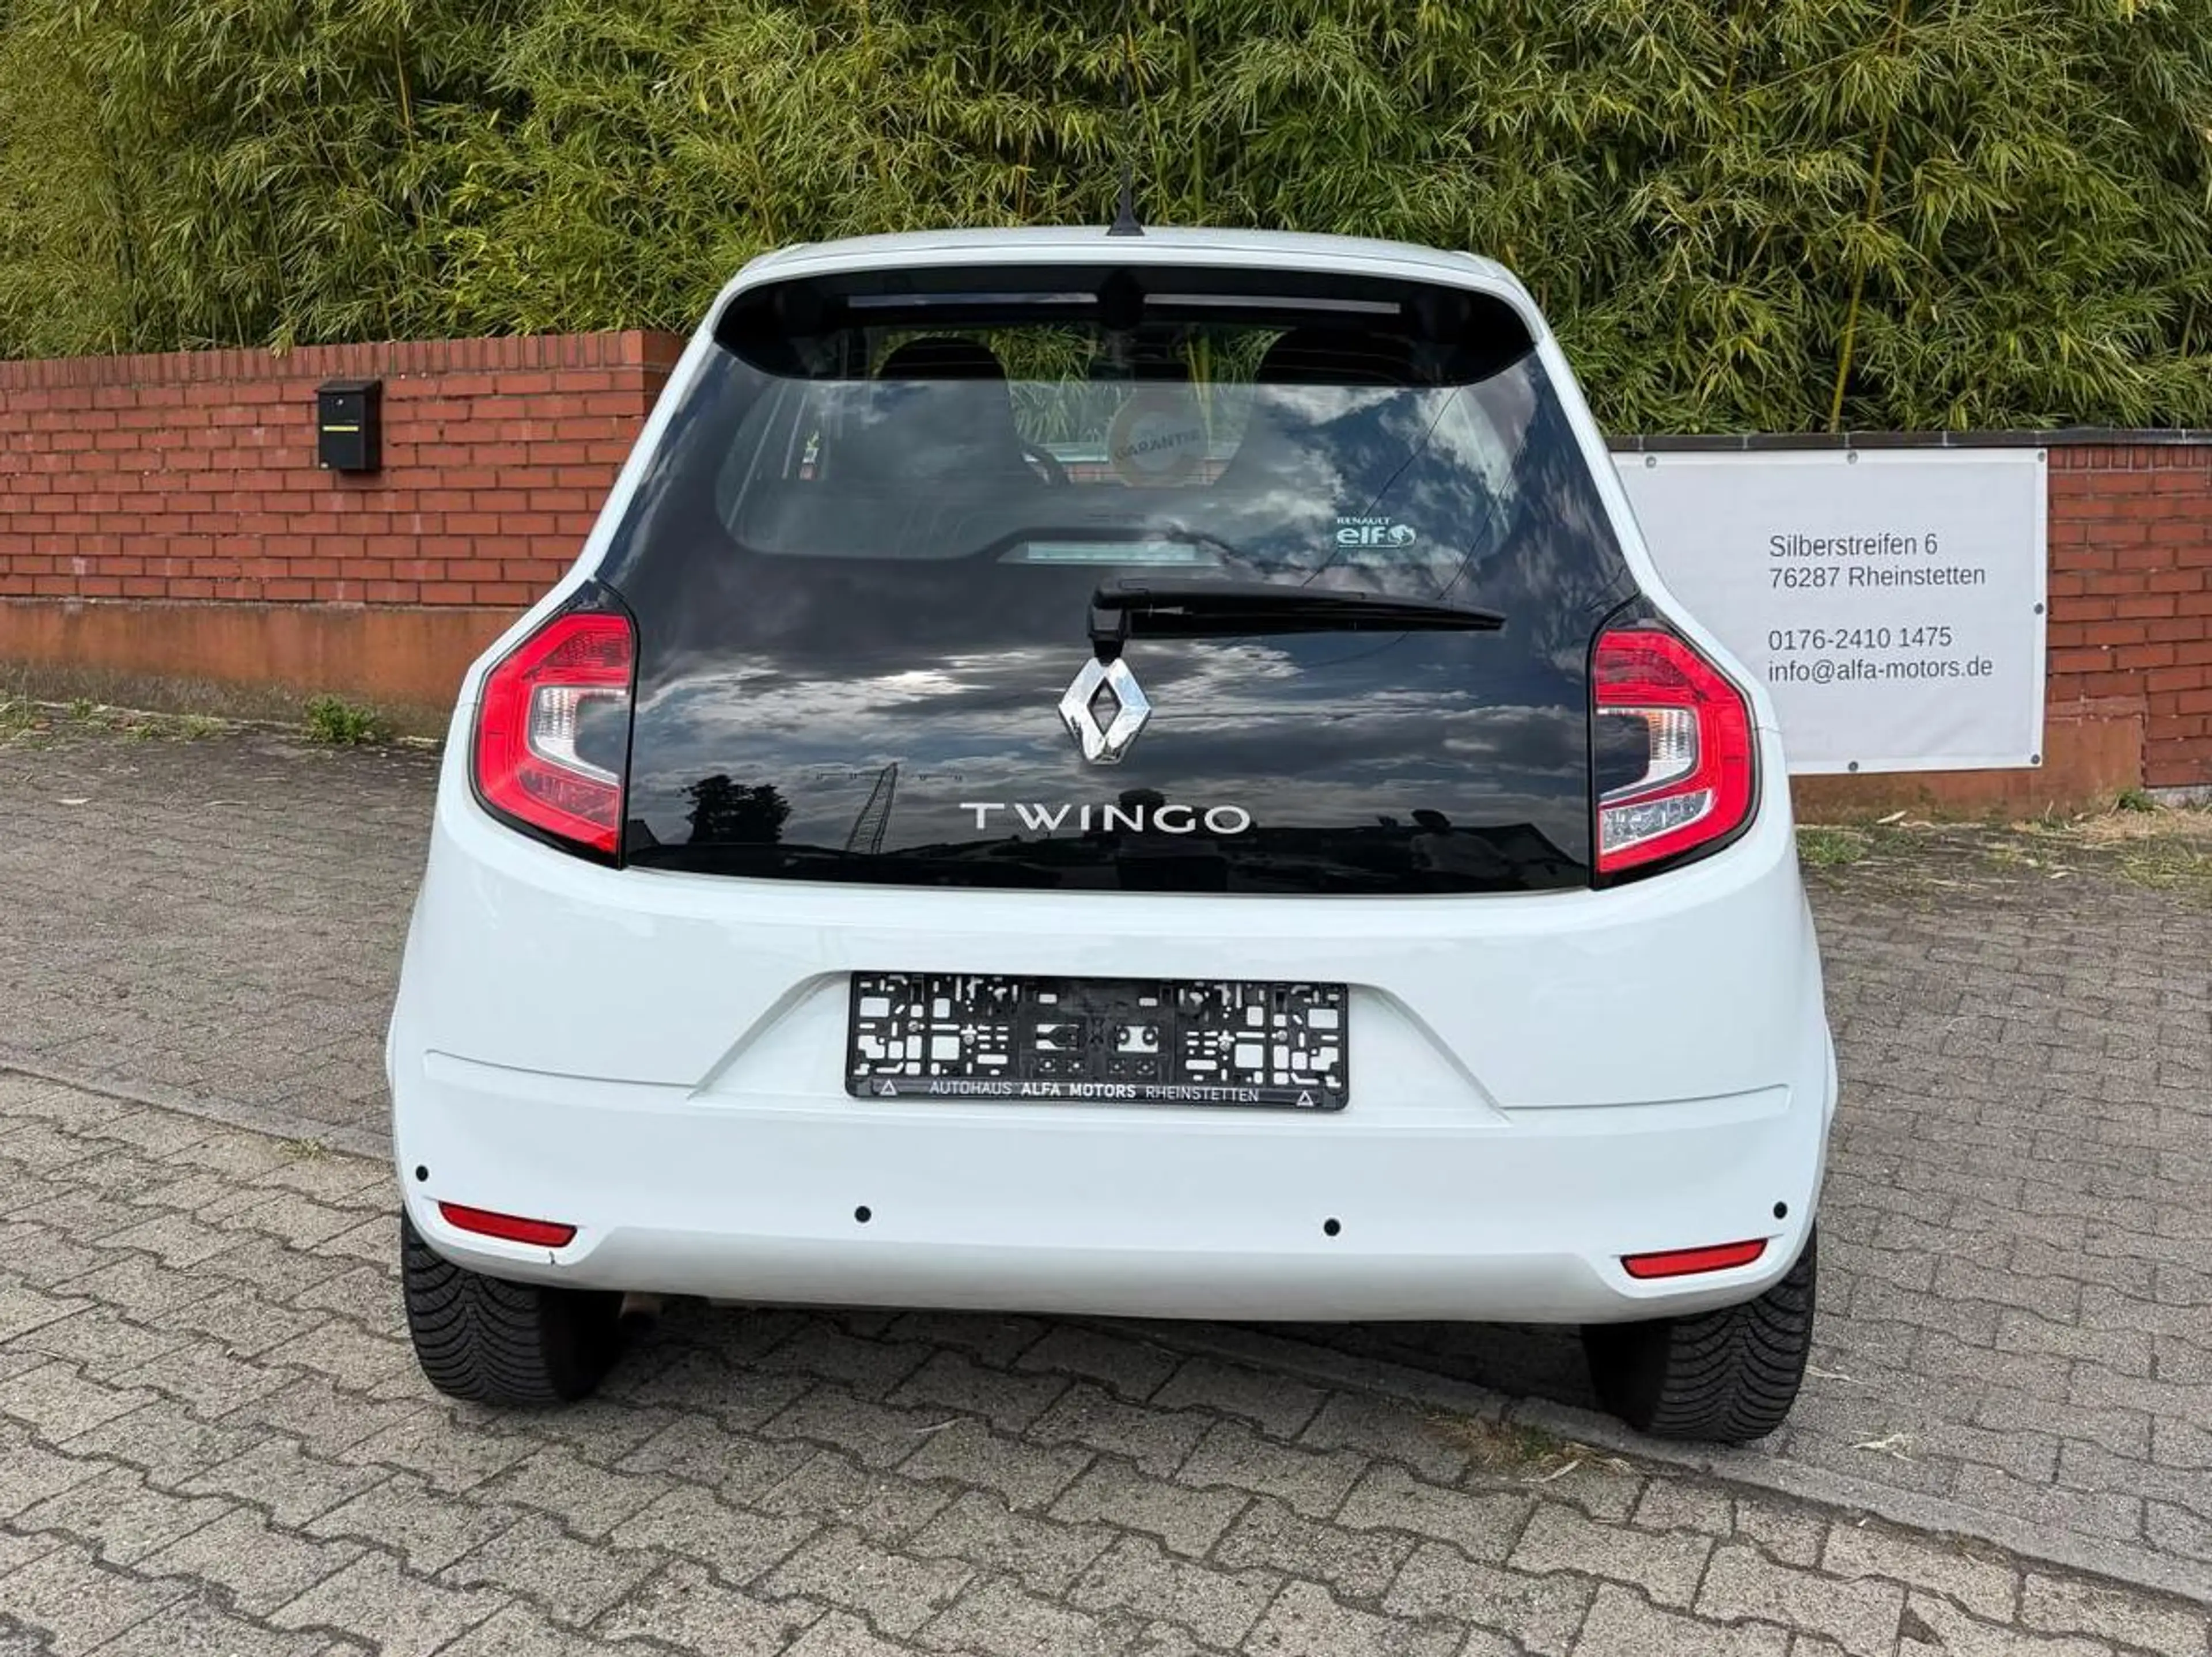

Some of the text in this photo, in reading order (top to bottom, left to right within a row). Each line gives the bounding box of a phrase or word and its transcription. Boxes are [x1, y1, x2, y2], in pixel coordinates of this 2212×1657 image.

[1336, 517, 1392, 525] RENAULT
[1768, 533, 1938, 558] Silberstreifen 6
[1769, 566, 1986, 588] 76287 Rheinstetten
[1768, 626, 1952, 651] 0176-2410 1475
[1768, 655, 1993, 684] info@alfa-motors.de
[959, 802, 1251, 835] TWINGO
[929, 1080, 1261, 1103] AUTOHAUS ALFA MOTORS RHEINSTETTEN
